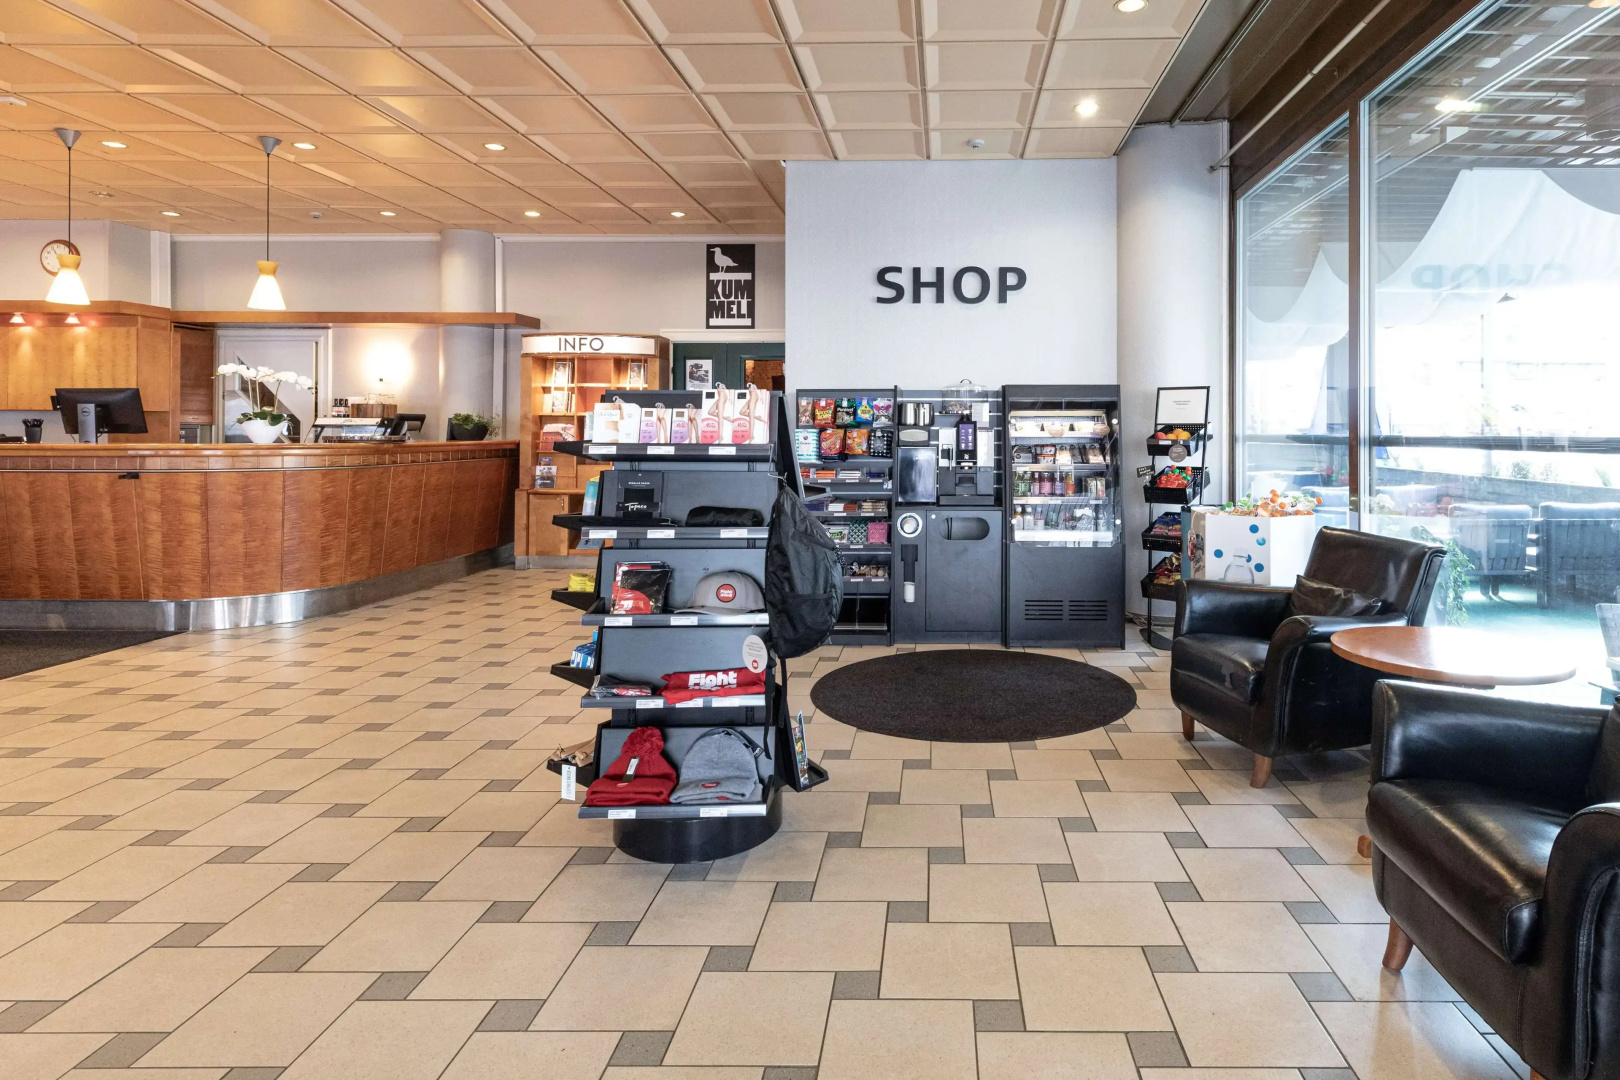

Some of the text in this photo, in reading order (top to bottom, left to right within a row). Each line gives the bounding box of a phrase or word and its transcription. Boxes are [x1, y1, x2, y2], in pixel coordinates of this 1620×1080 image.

[709, 279, 751, 300] KUM
[876, 266, 1027, 304] SHOP
[709, 300, 751, 319] MELI
[559, 337, 604, 352] INFO
[688, 671, 738, 689] Fight
